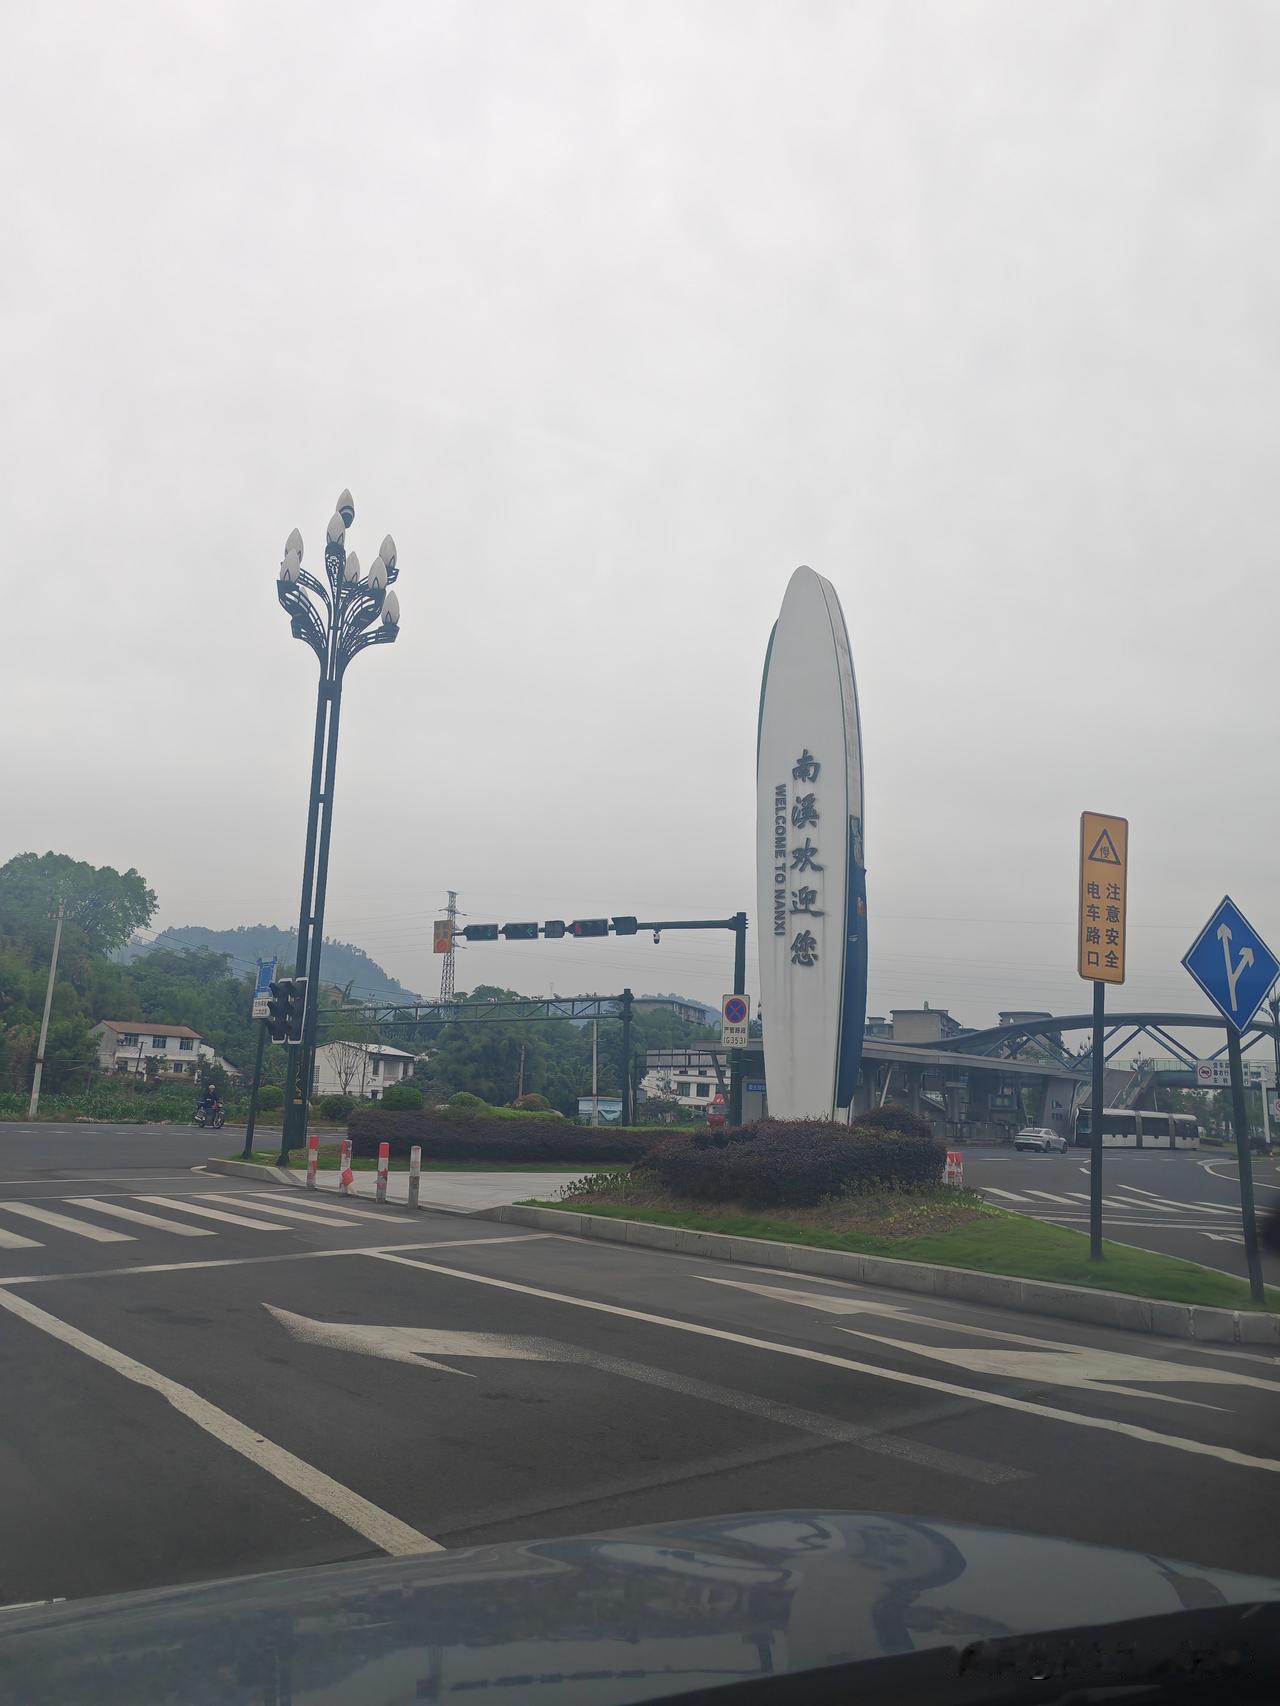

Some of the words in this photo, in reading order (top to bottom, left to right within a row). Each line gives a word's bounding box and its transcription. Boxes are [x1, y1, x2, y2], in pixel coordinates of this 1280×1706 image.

[774, 784, 787, 858] WELCOME
[790, 749, 824, 967] 南溪欢迎您
[774, 863, 787, 884] TO
[774, 889, 786, 936] NANXI
[1086, 881, 1101, 967] 电车路口
[1105, 883, 1121, 968] 注意安全
